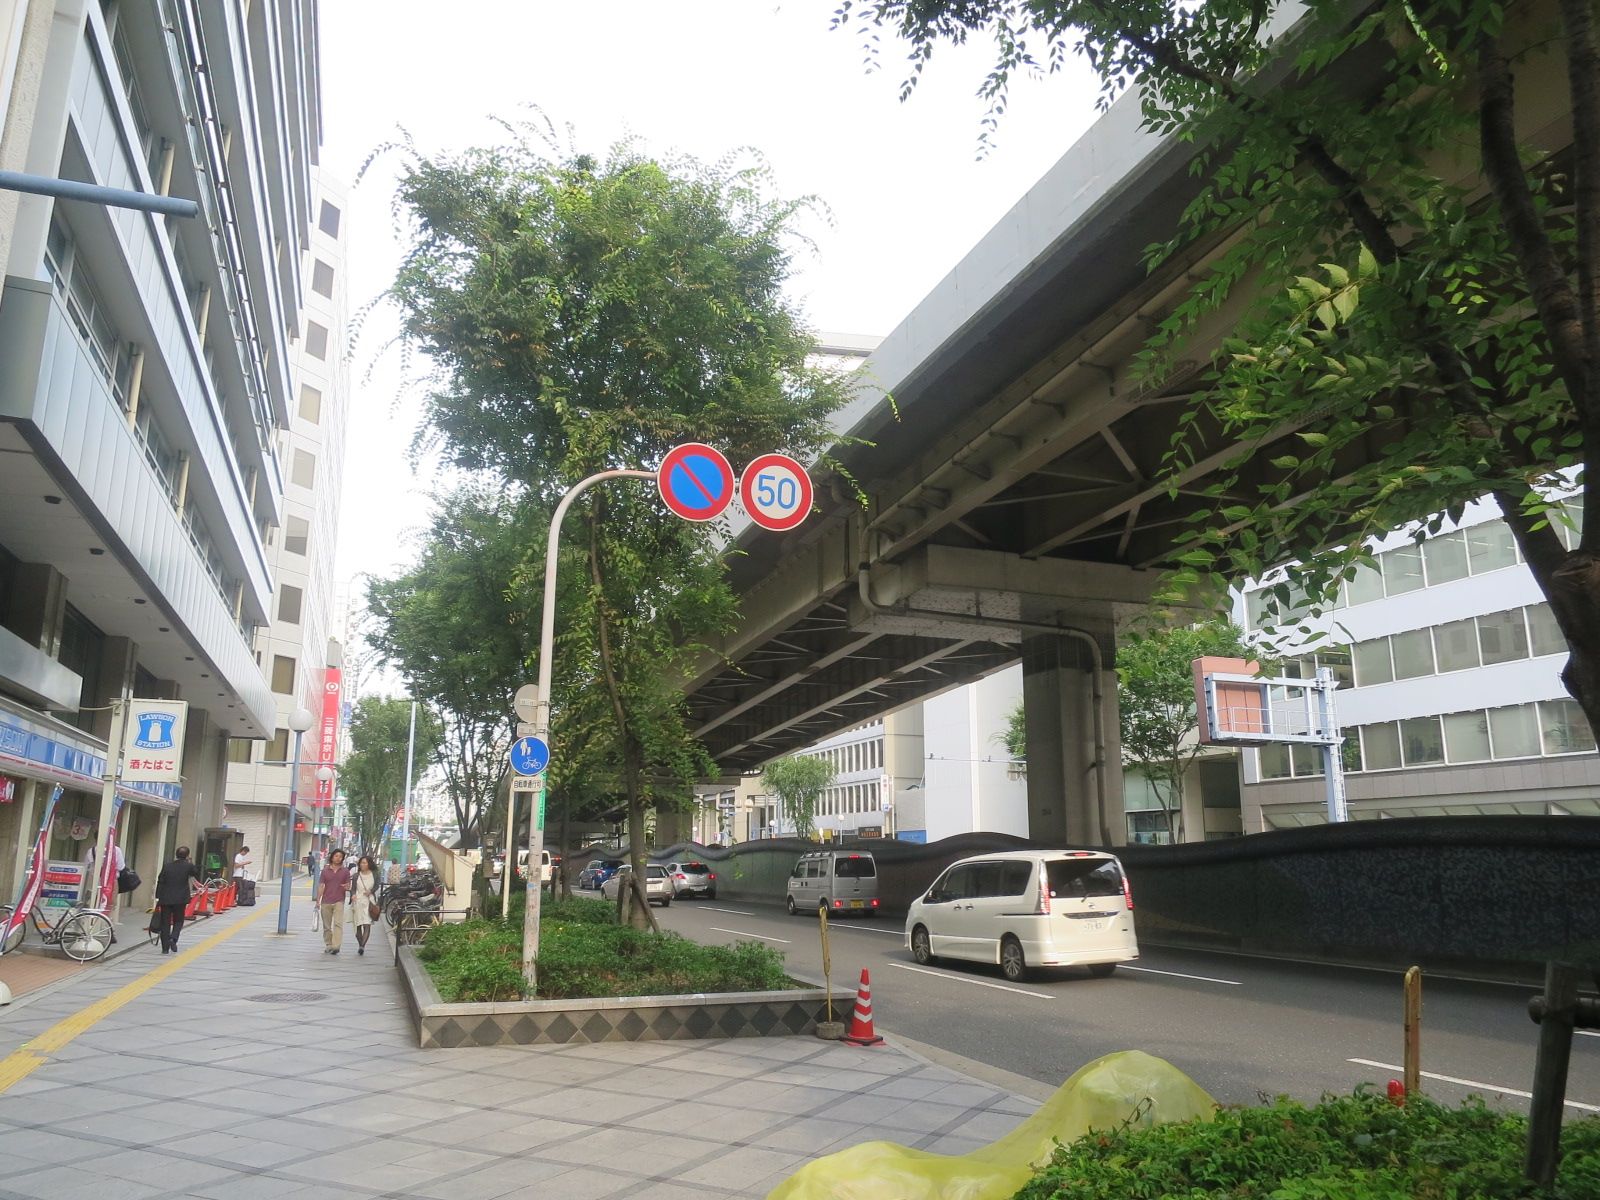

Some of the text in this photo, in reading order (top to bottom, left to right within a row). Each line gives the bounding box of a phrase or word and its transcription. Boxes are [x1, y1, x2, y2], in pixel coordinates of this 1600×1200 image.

[758, 475, 796, 509] 50
[140, 714, 175, 722] LAWSON
[136, 740, 171, 748] STATION
